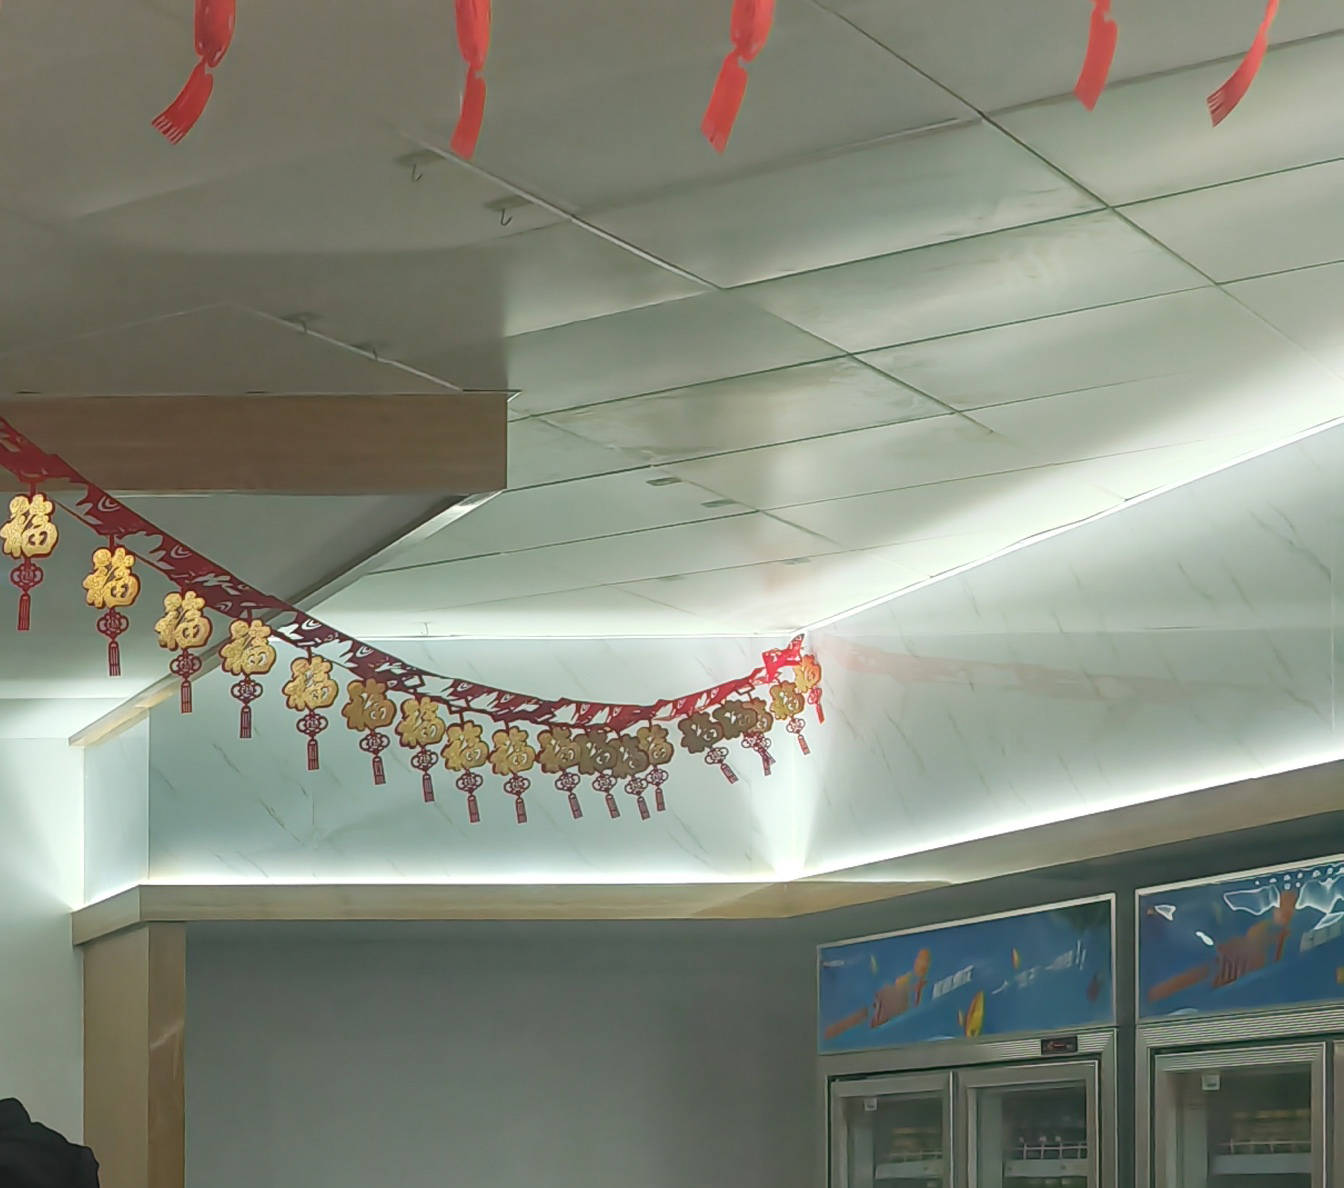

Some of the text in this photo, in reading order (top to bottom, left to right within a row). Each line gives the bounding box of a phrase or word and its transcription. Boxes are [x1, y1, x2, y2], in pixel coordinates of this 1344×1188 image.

[0, 494, 58, 558] 福
[84, 547, 141, 607] 福
[155, 592, 212, 650] 福
